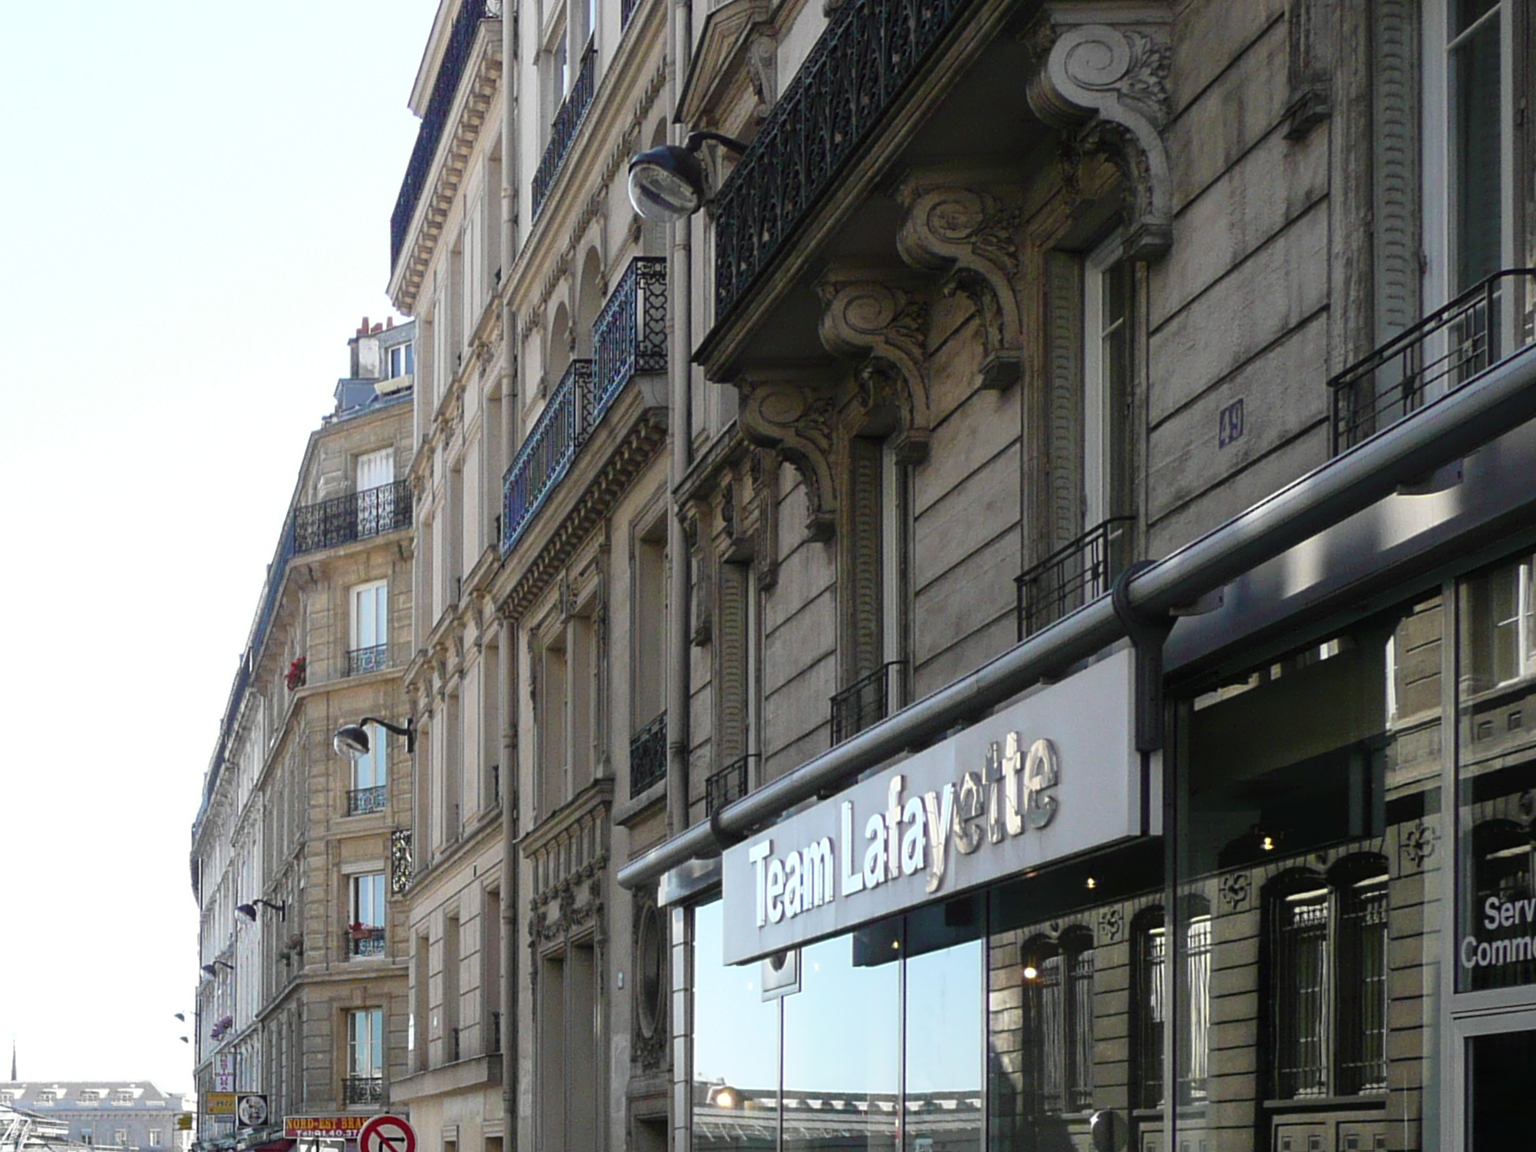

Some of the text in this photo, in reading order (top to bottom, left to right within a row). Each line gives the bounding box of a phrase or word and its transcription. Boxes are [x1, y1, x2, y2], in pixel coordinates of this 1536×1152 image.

[1221, 403, 1242, 444] 49
[749, 731, 1060, 928] Team Lafayette
[1461, 935, 1536, 968] Comm
[286, 1117, 338, 1130] NORD-EST
